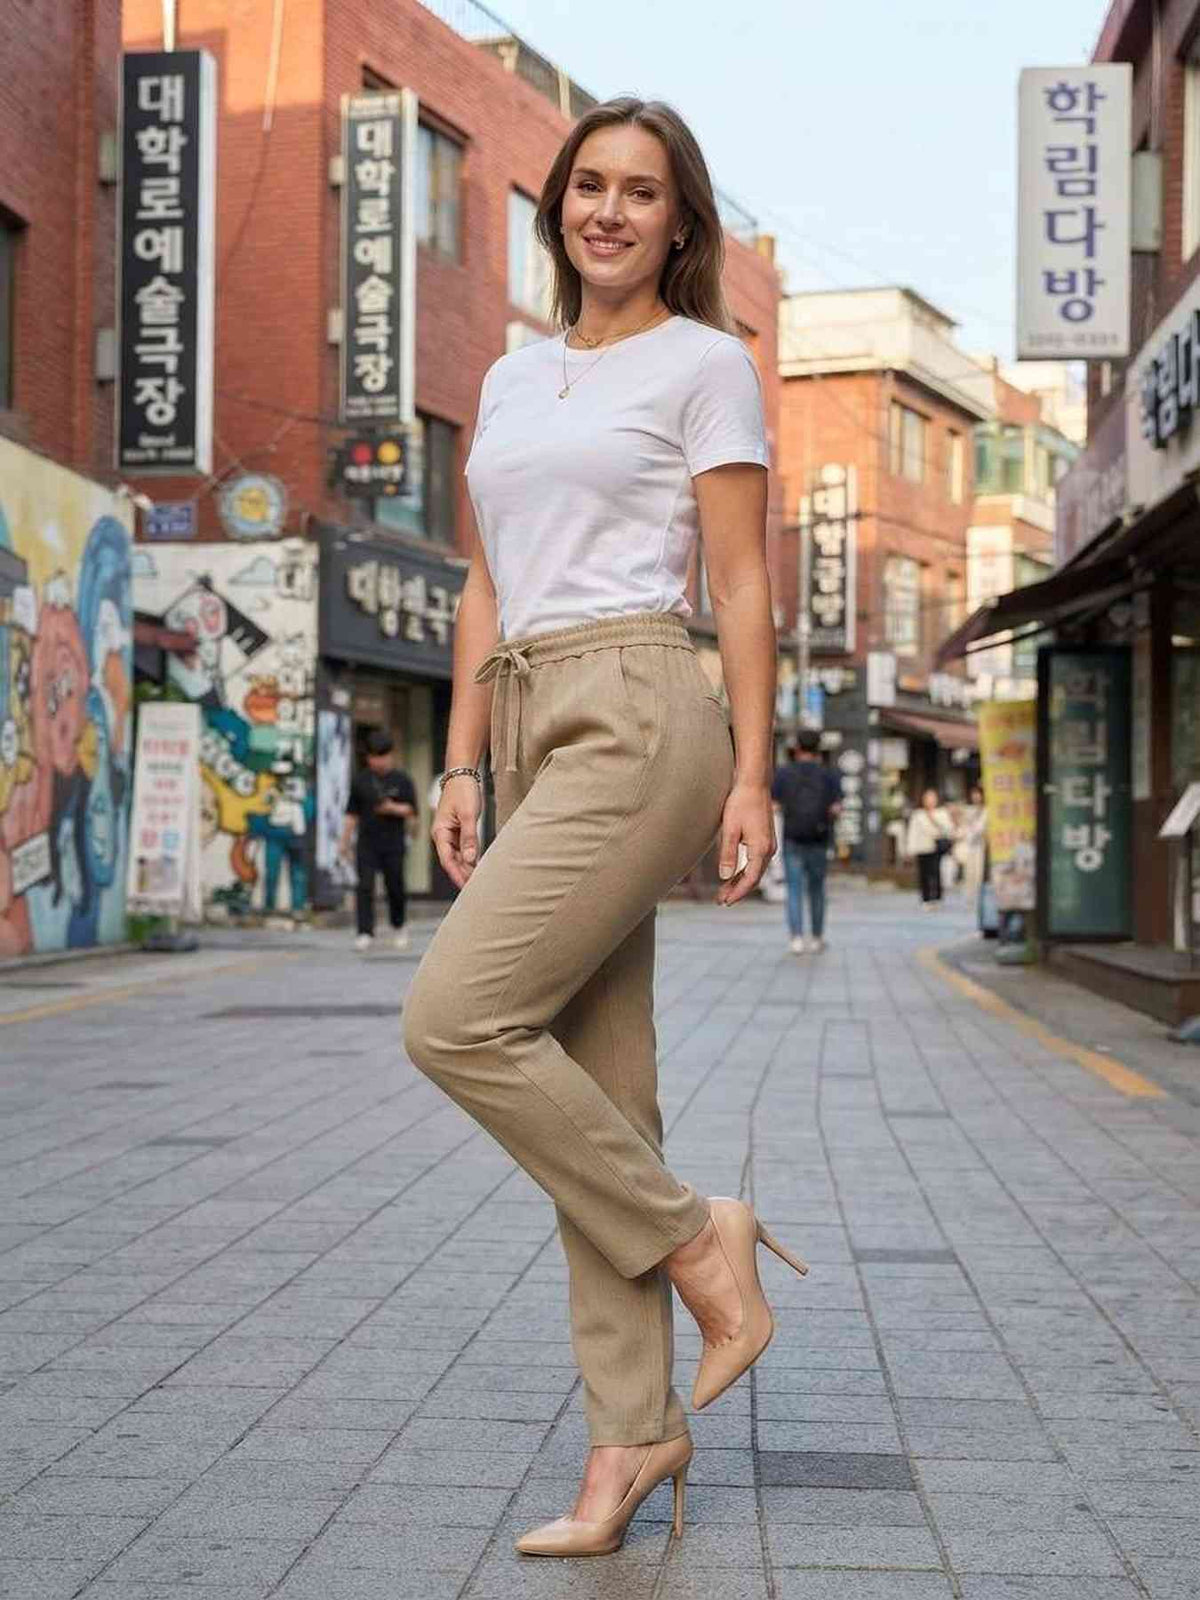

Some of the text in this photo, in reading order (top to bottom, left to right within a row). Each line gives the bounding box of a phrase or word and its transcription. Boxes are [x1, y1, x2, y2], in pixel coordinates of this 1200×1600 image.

[134, 73, 187, 426] 대학로예술극장
[354, 120, 396, 393] 대학로예술극장
[1043, 81, 1107, 323] 학림다방
